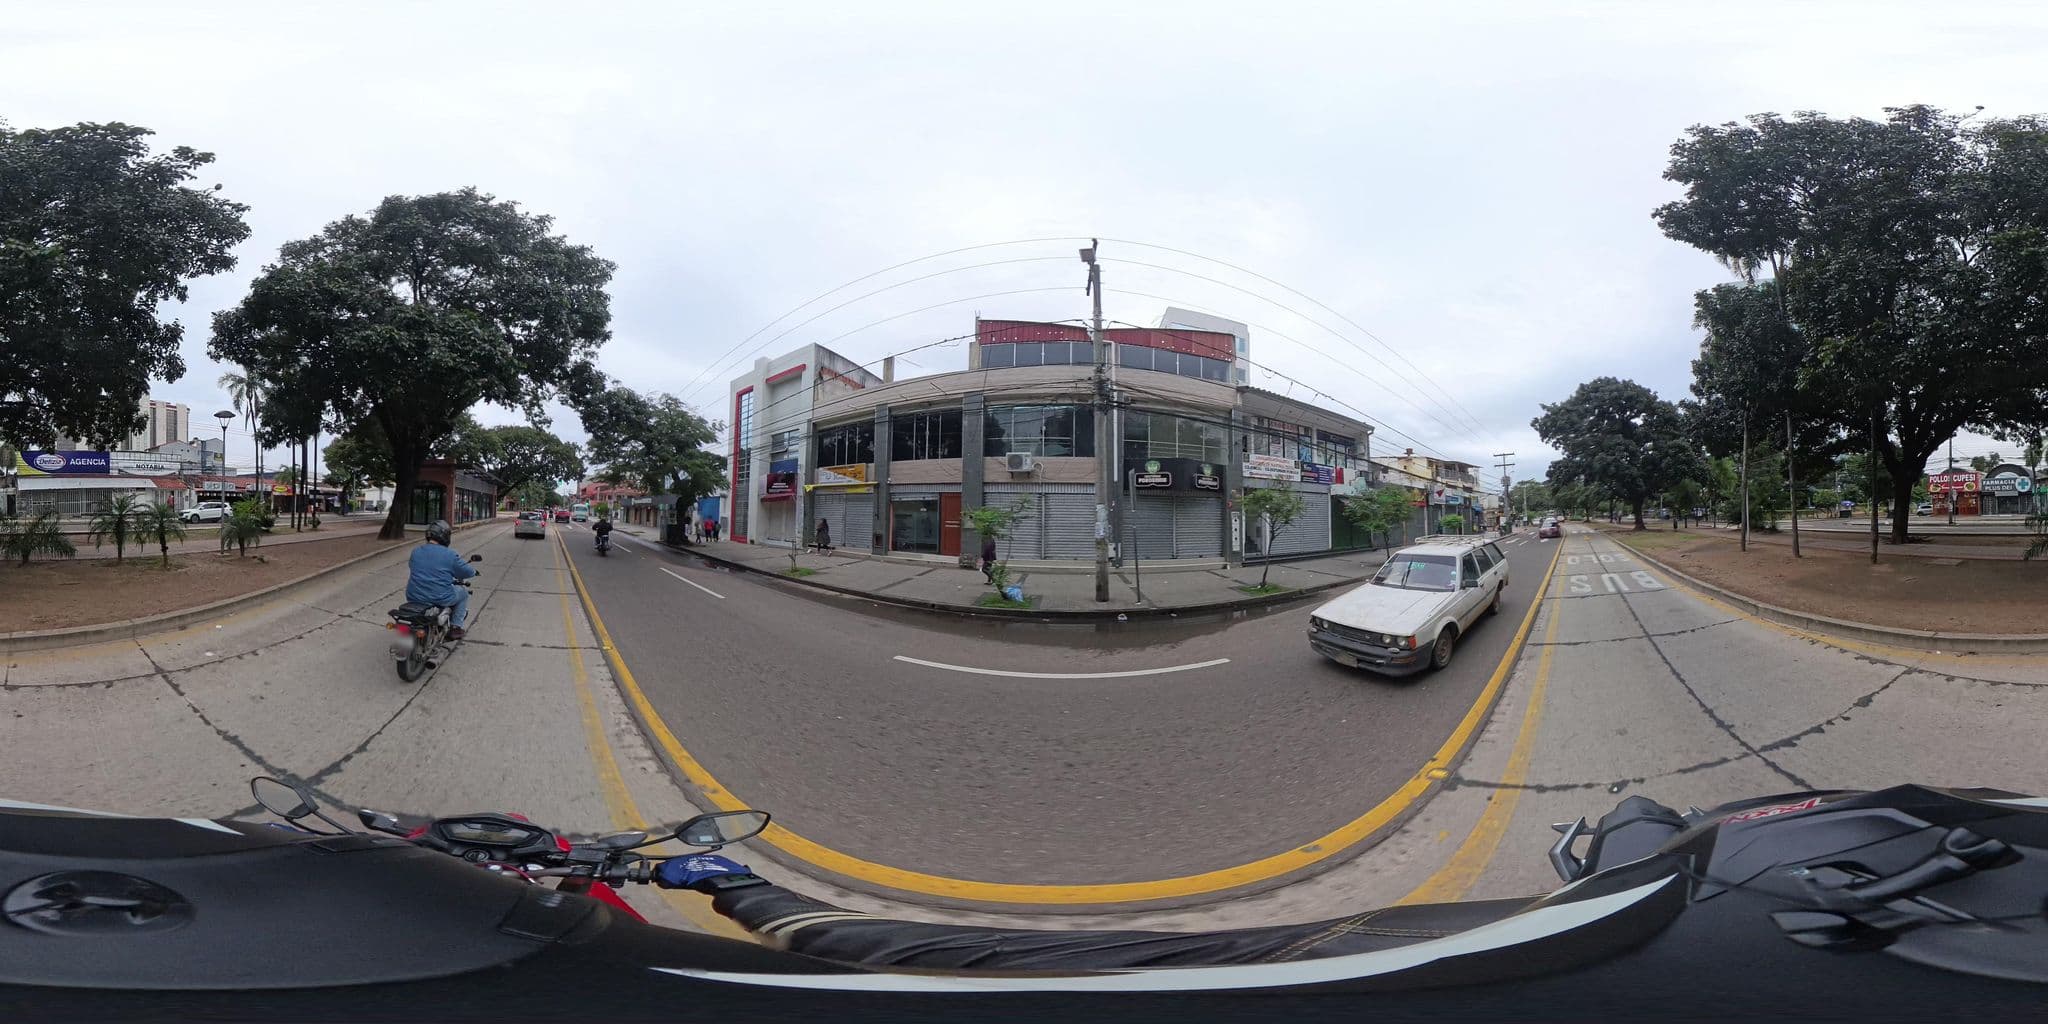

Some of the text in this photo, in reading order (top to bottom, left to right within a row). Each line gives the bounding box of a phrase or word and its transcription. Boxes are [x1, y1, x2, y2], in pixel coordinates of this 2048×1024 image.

[70, 458, 106, 466] AGENCIA
[1953, 474, 1976, 482] CUPESI
[1570, 571, 1666, 593] BUS
